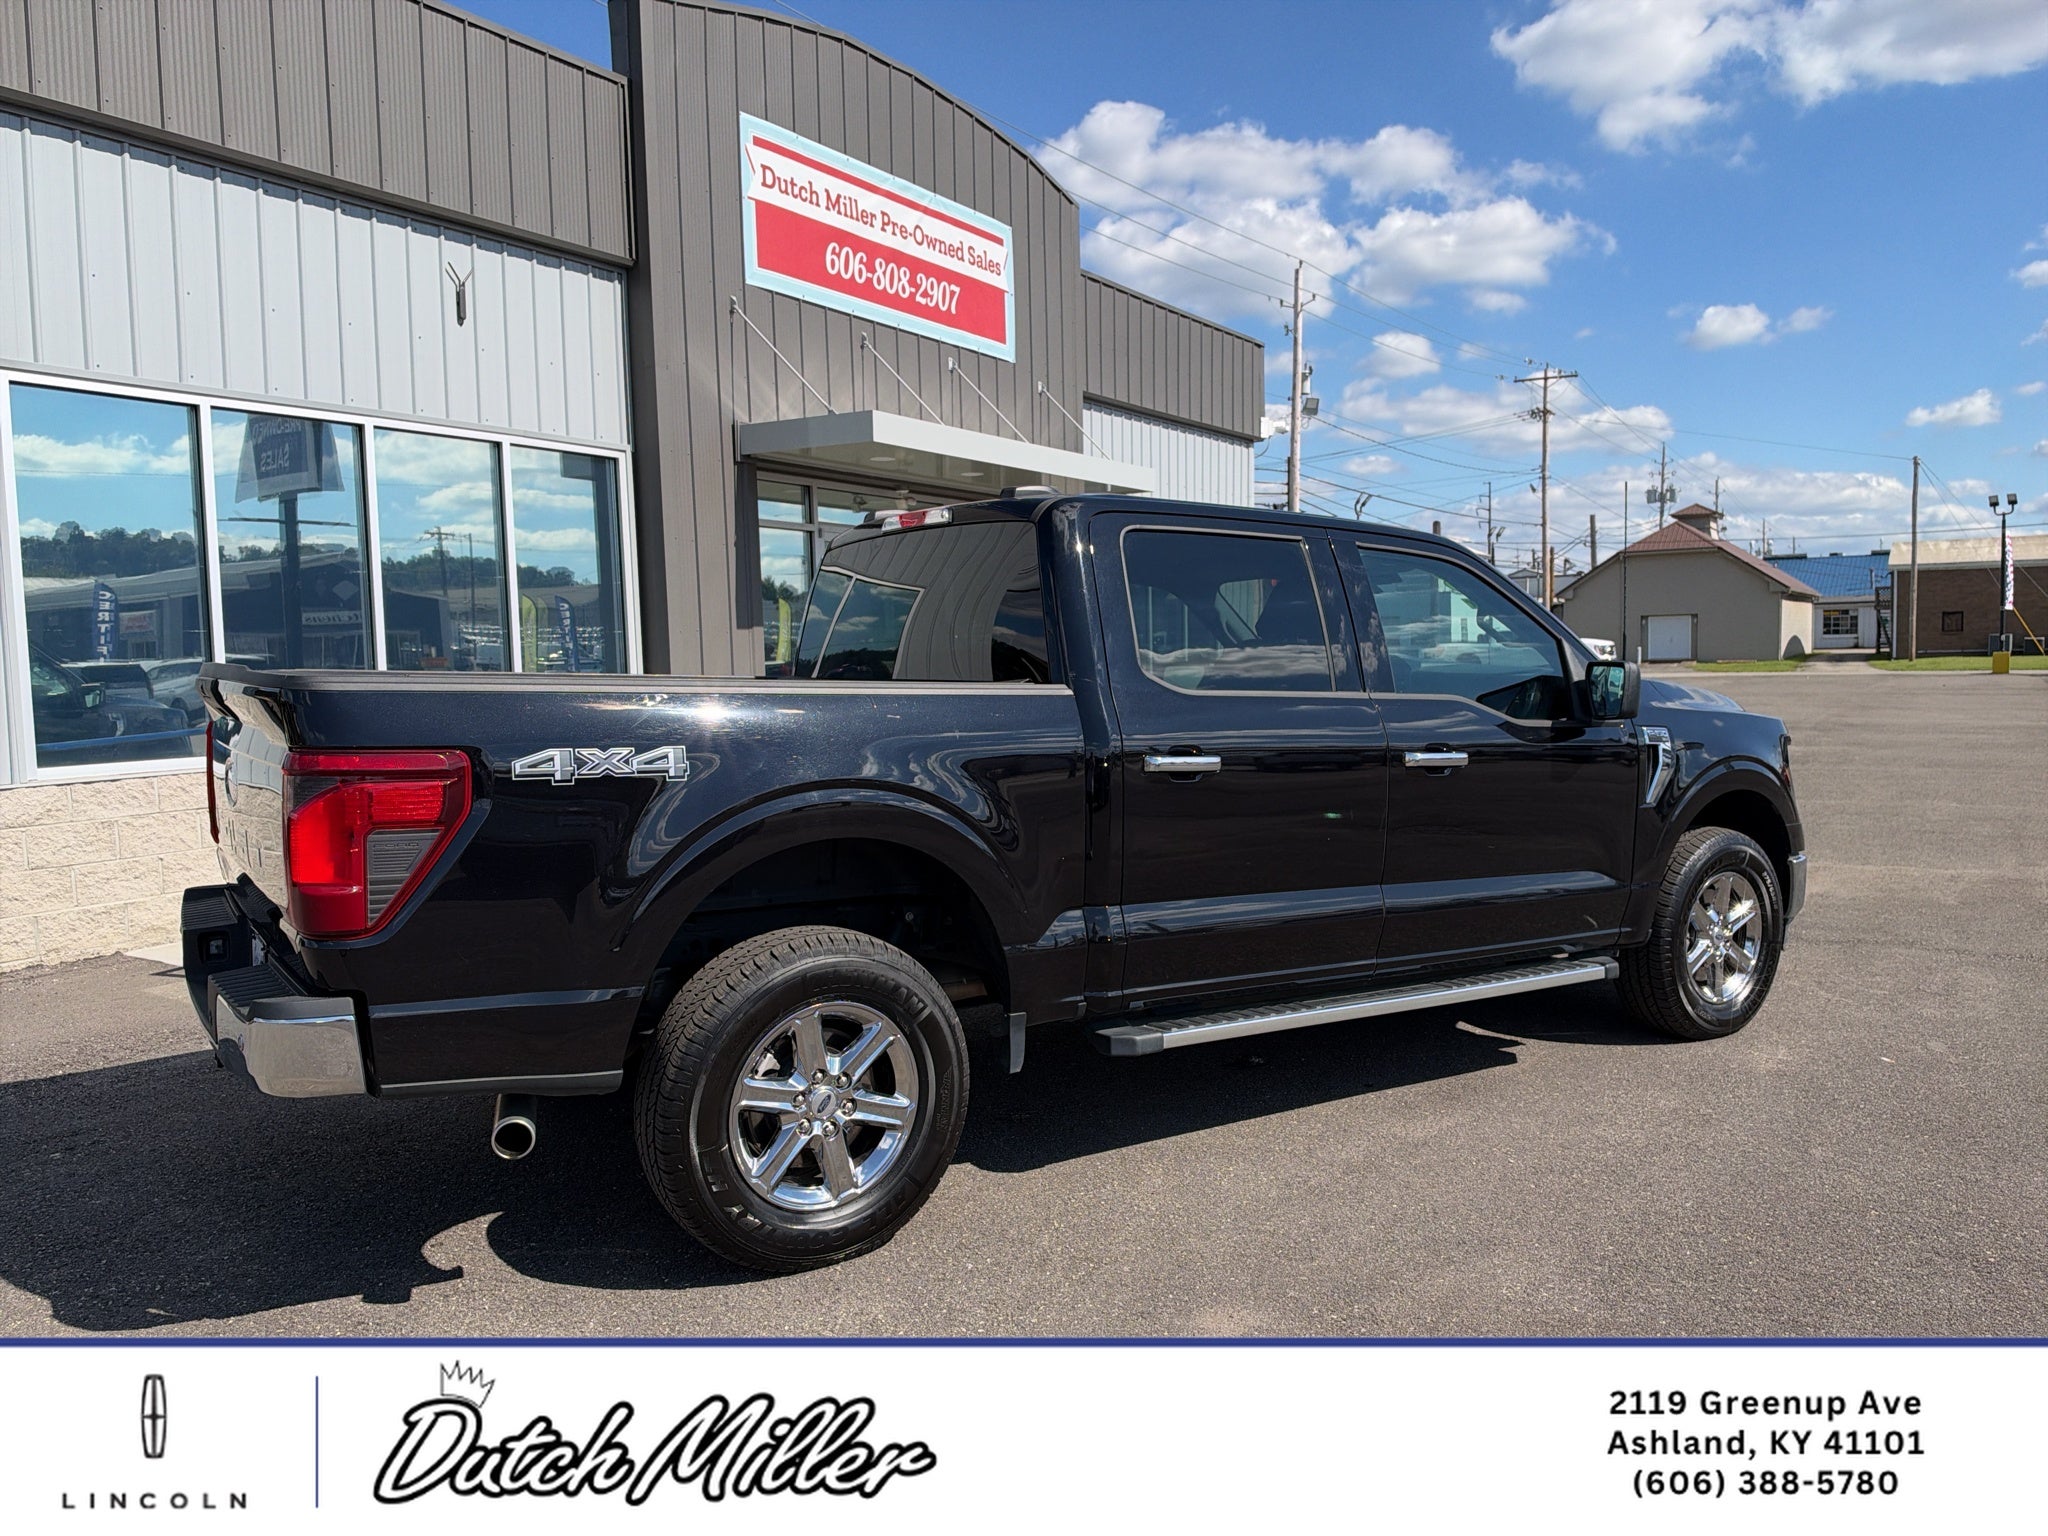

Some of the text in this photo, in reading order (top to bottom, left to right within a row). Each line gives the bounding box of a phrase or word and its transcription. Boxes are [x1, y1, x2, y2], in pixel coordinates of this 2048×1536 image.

[760, 163, 1002, 277] Dutch Miller Pre-Owned Sales
[825, 242, 961, 314] 606-808-2907
